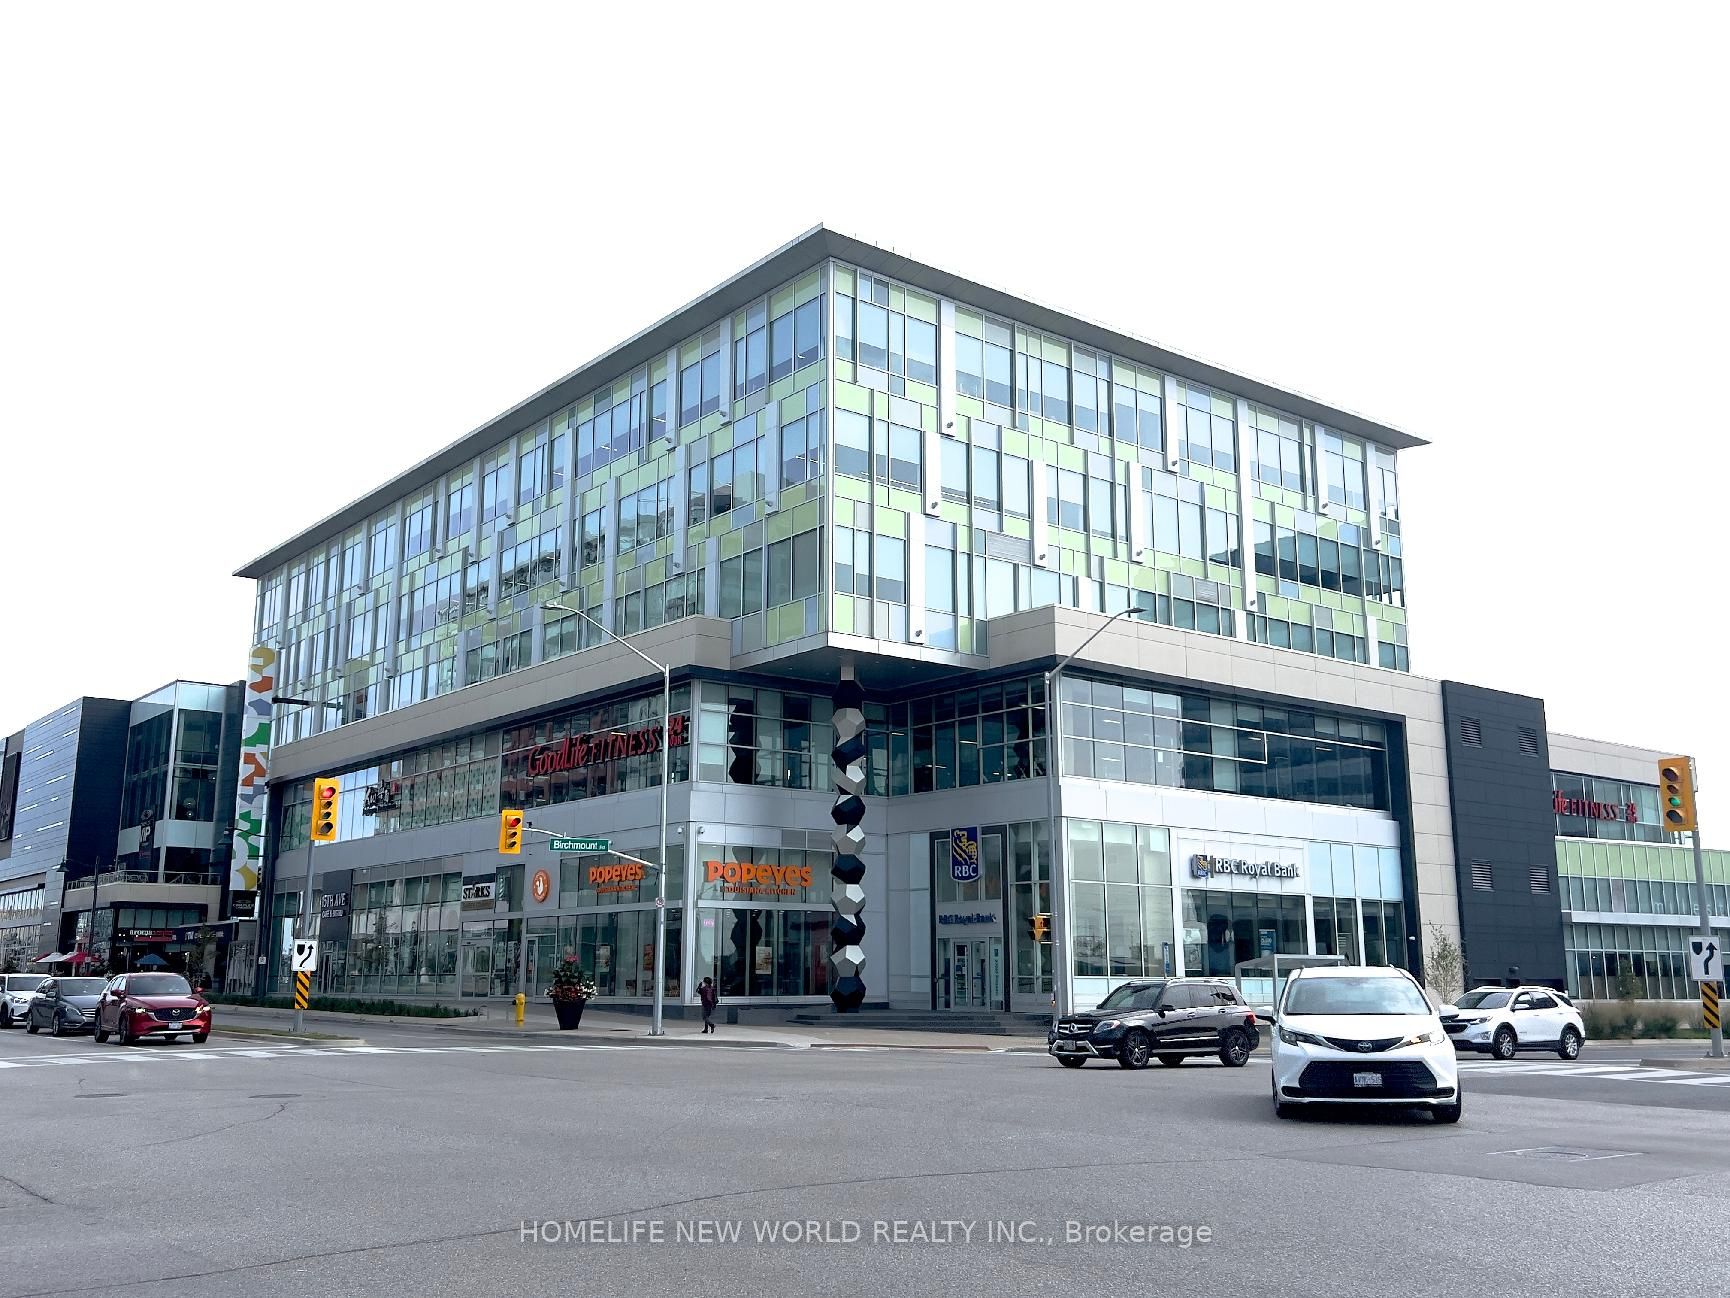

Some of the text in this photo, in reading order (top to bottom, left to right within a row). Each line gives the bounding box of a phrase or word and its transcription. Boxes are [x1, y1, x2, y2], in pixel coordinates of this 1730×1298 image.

[527, 727, 661, 776] GoodLife FITNESS
[1571, 798, 1618, 820] FITNESS
[553, 840, 598, 850] Birchmount
[954, 865, 977, 877] RBC
[1216, 858, 1300, 880] RBC Royal Bank
